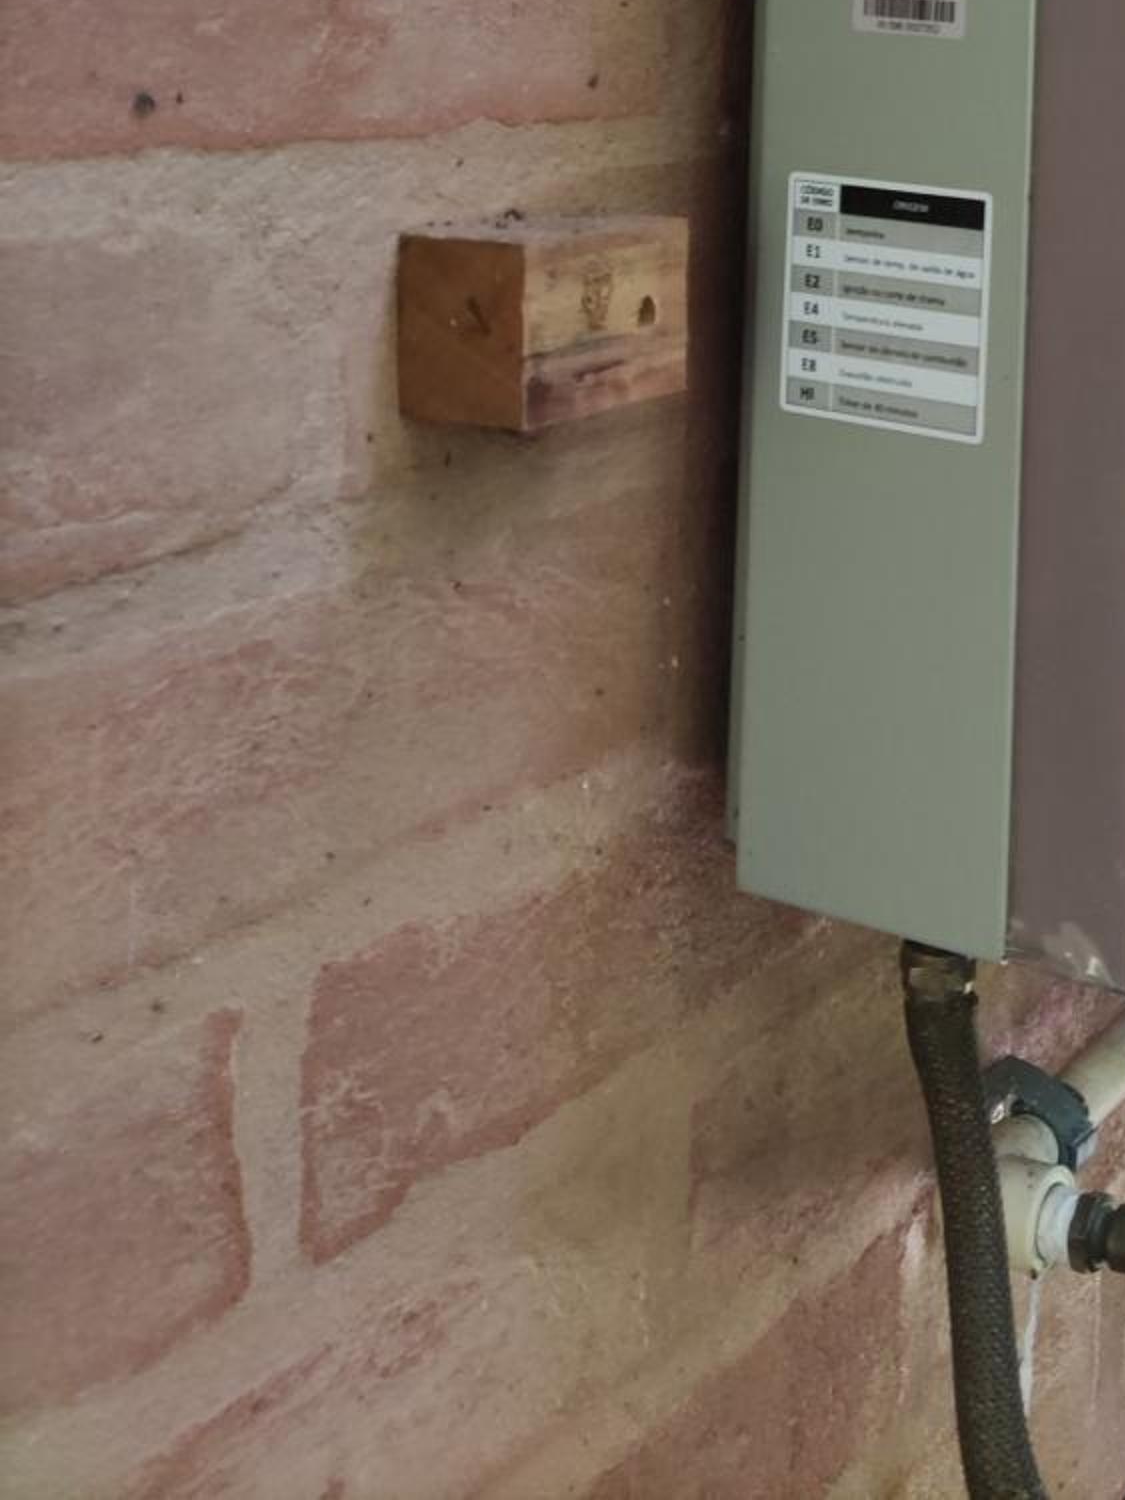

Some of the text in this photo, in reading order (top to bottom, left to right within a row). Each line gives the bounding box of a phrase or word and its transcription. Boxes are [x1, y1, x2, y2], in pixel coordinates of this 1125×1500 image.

[806, 243, 821, 259] E1
[804, 273, 820, 288] E2
[803, 301, 819, 316] E4
[802, 329, 818, 345] E5
